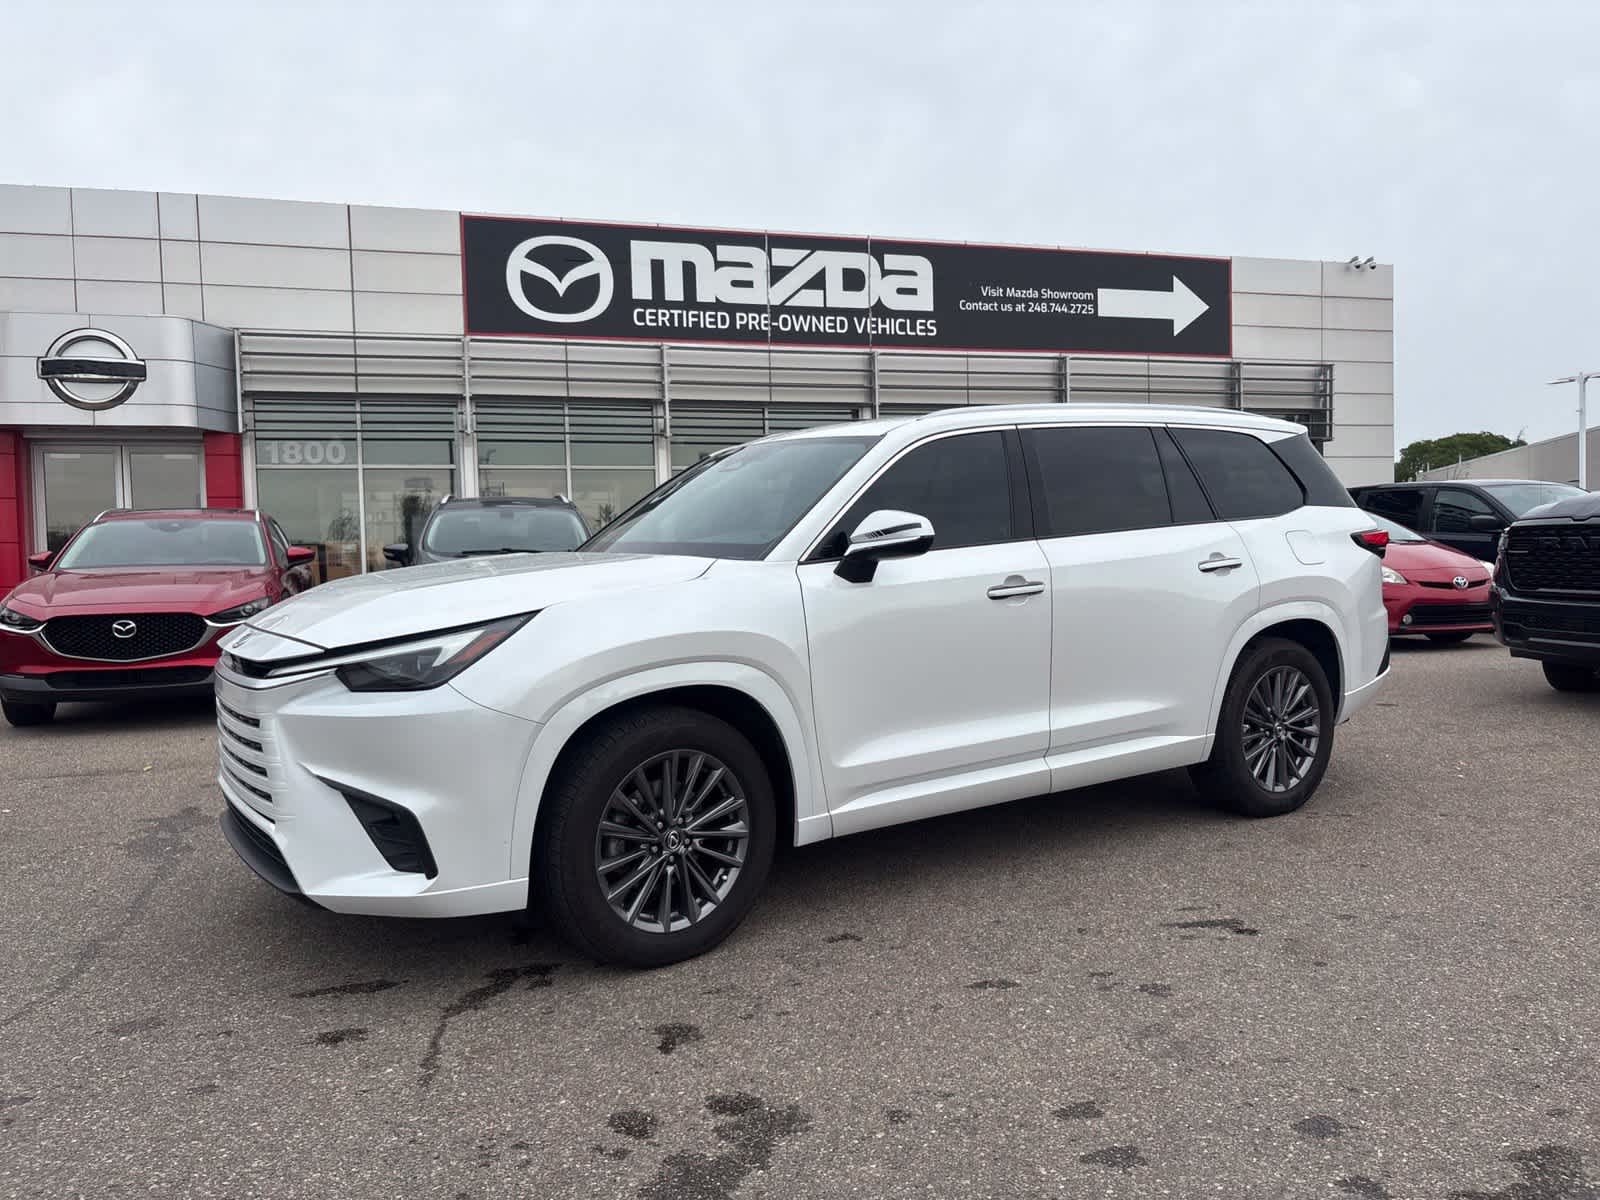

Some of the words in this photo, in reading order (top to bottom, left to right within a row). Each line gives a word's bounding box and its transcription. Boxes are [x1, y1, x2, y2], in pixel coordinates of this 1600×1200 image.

[980, 286, 1004, 297] Visit
[1006, 287, 1039, 298] Mazda
[1041, 288, 1094, 300] Showroom
[959, 300, 999, 311] Contact
[1001, 302, 1013, 312] us
[1015, 302, 1026, 312] at
[1028, 302, 1094, 314] 248.744.2725
[633, 308, 730, 329] CERTIFIED
[735, 312, 848, 332] PRE-OWNED
[853, 316, 937, 336] VEHICLES
[265, 440, 346, 464] 1800
